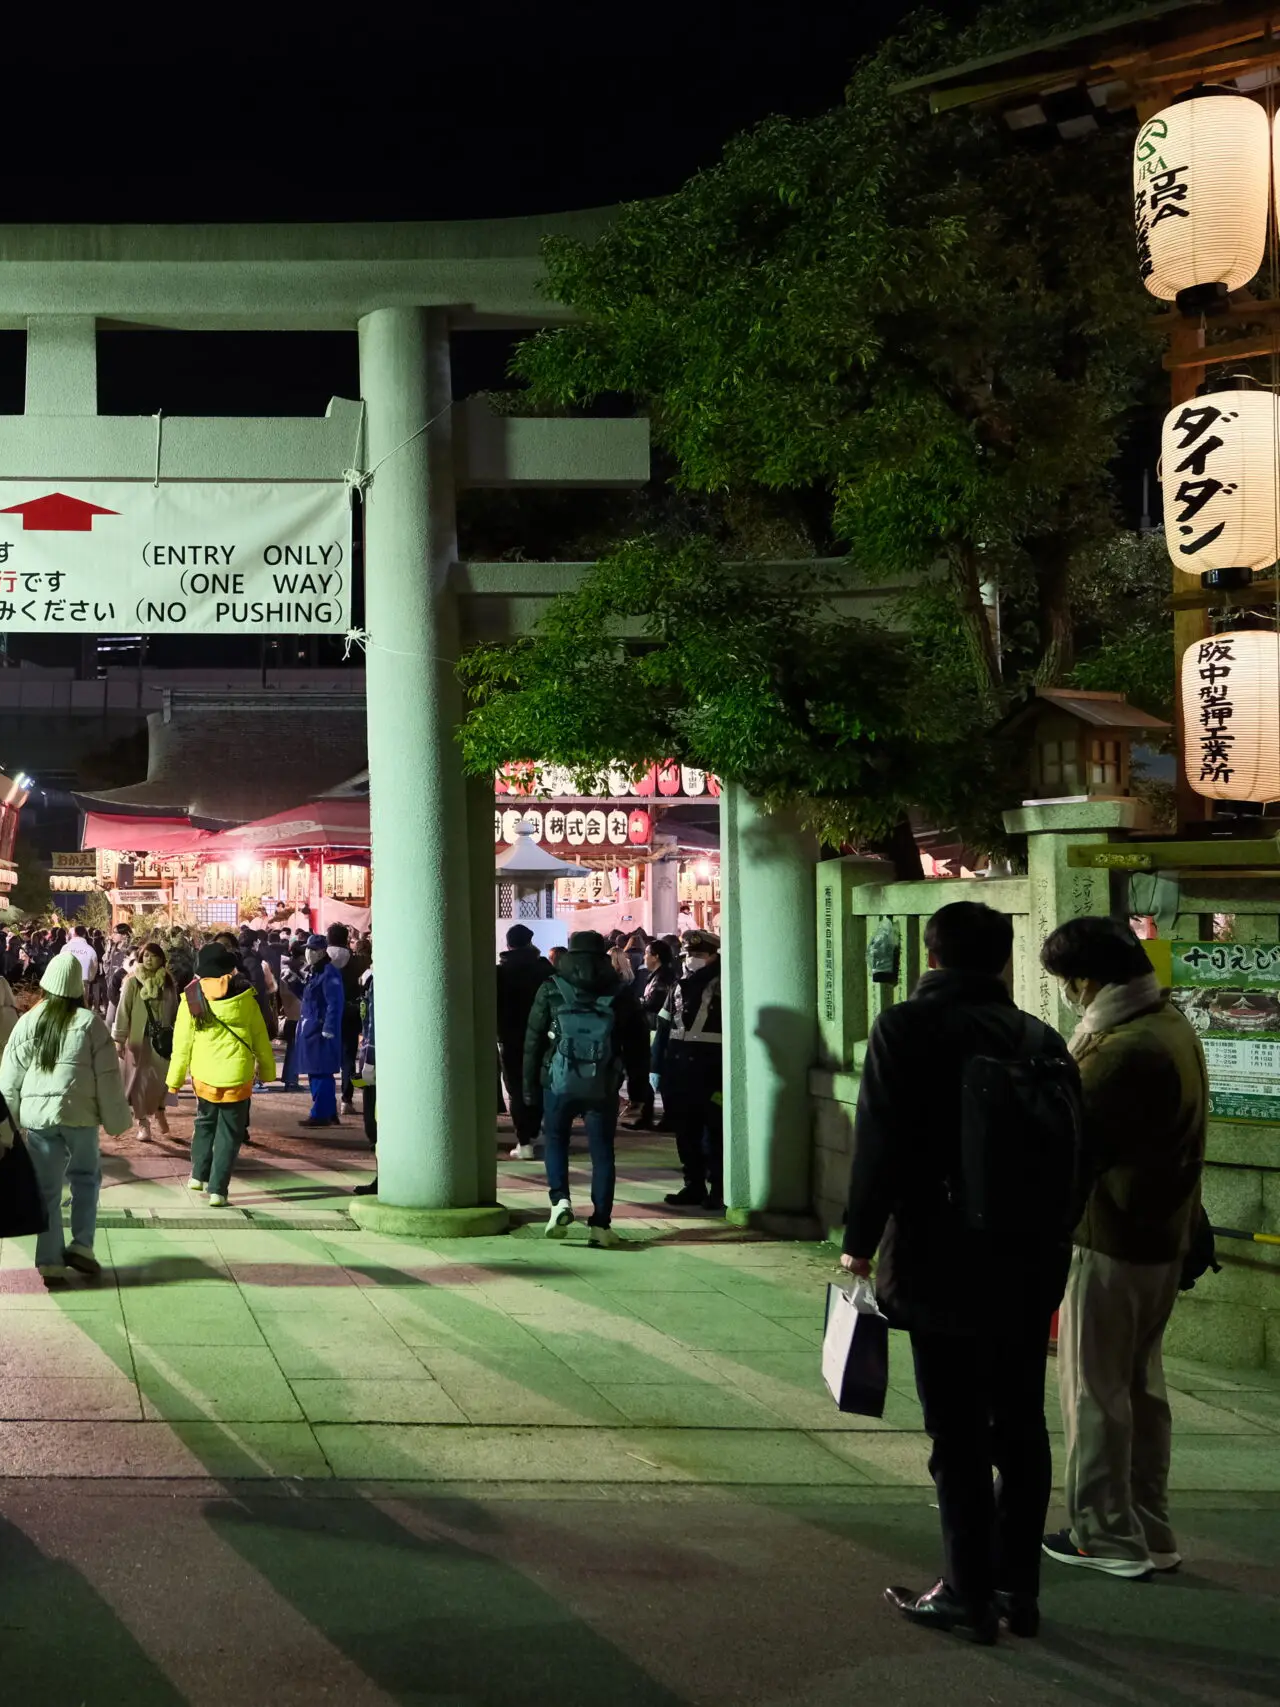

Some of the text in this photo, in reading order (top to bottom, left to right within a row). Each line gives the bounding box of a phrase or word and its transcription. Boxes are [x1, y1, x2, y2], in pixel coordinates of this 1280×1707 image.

[1150, 166, 1190, 228] JRA
[1172, 405, 1239, 556] ダイダン
[142, 540, 344, 568] (ENTRY ONLY)
[180, 569, 344, 597] (ONE WAY)
[135, 597, 344, 625] (NO PUSHING)
[1197, 638, 1238, 784] 阪中型押工業所
